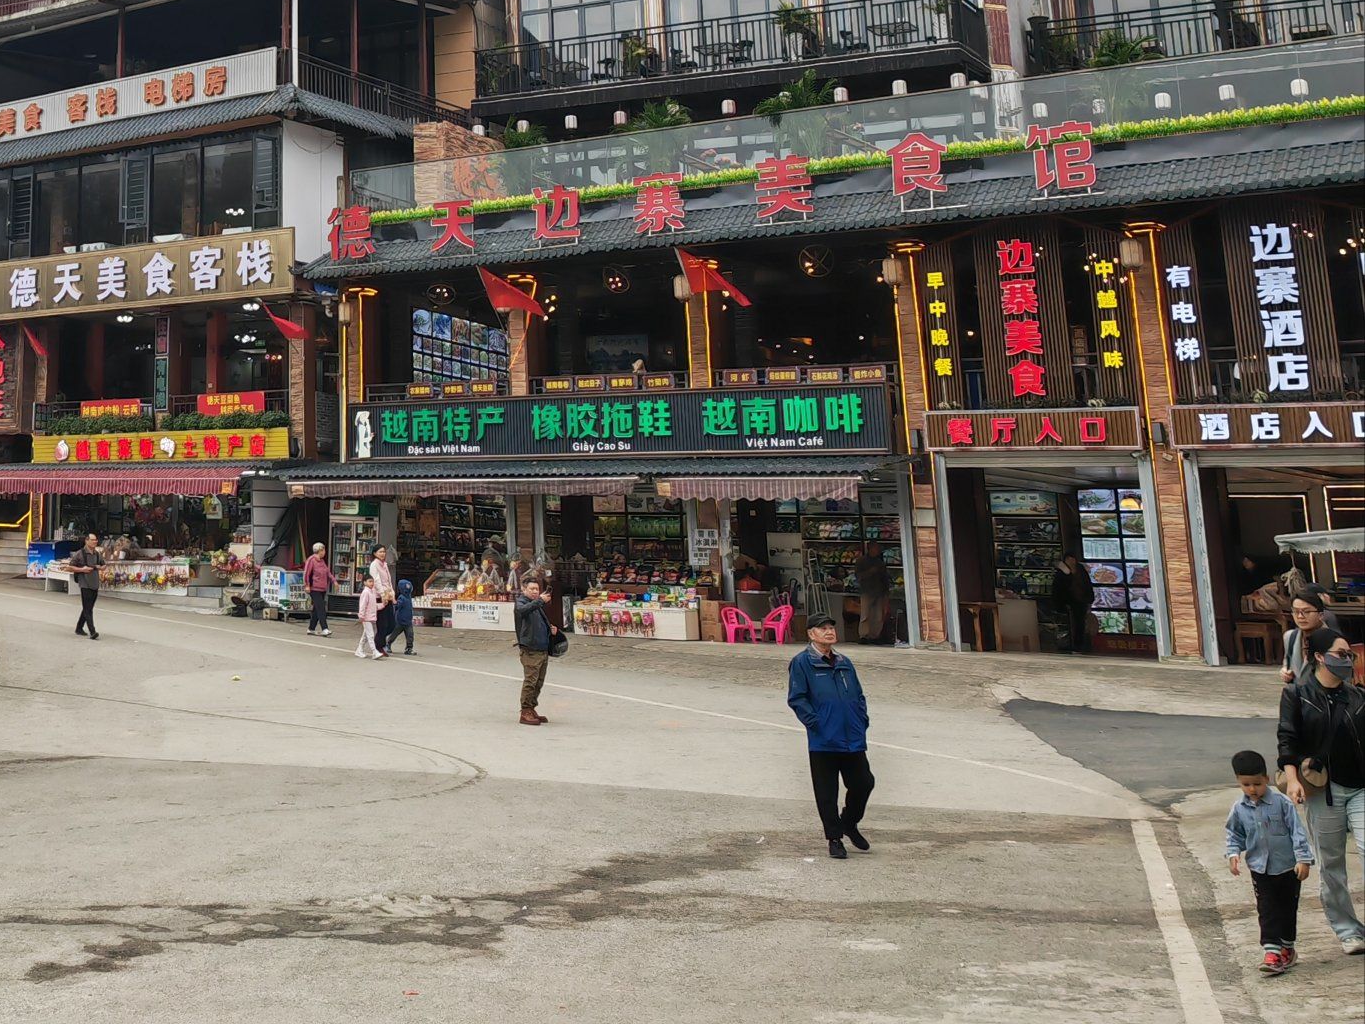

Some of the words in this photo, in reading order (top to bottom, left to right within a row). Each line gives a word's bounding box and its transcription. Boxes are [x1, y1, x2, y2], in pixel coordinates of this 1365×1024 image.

[66, 87, 119, 124] 客栈
[143, 65, 228, 106] 电梯房
[326, 120, 1099, 260] 德天边寨美食馆
[9, 241, 274, 310] 德天美食客栈
[1248, 222, 1310, 393] 边寨酒店
[925, 271, 954, 377] 早中晚餐
[995, 239, 1046, 398] 边寨美食
[1093, 260, 1125, 369] 中越风味
[1165, 265, 1201, 362] 有电梯
[381, 406, 505, 444] 越南特产
[531, 398, 673, 441] 橡胶拖鞋
[702, 393, 864, 437] 越南咖啡
[463, 445, 481, 453] Nam
[597, 442, 615, 451] Cao
[617, 441, 631, 450] Su
[770, 438, 796, 448] Nam
[799, 436, 824, 447] Café
[946, 416, 1108, 445] 餐厅入口
